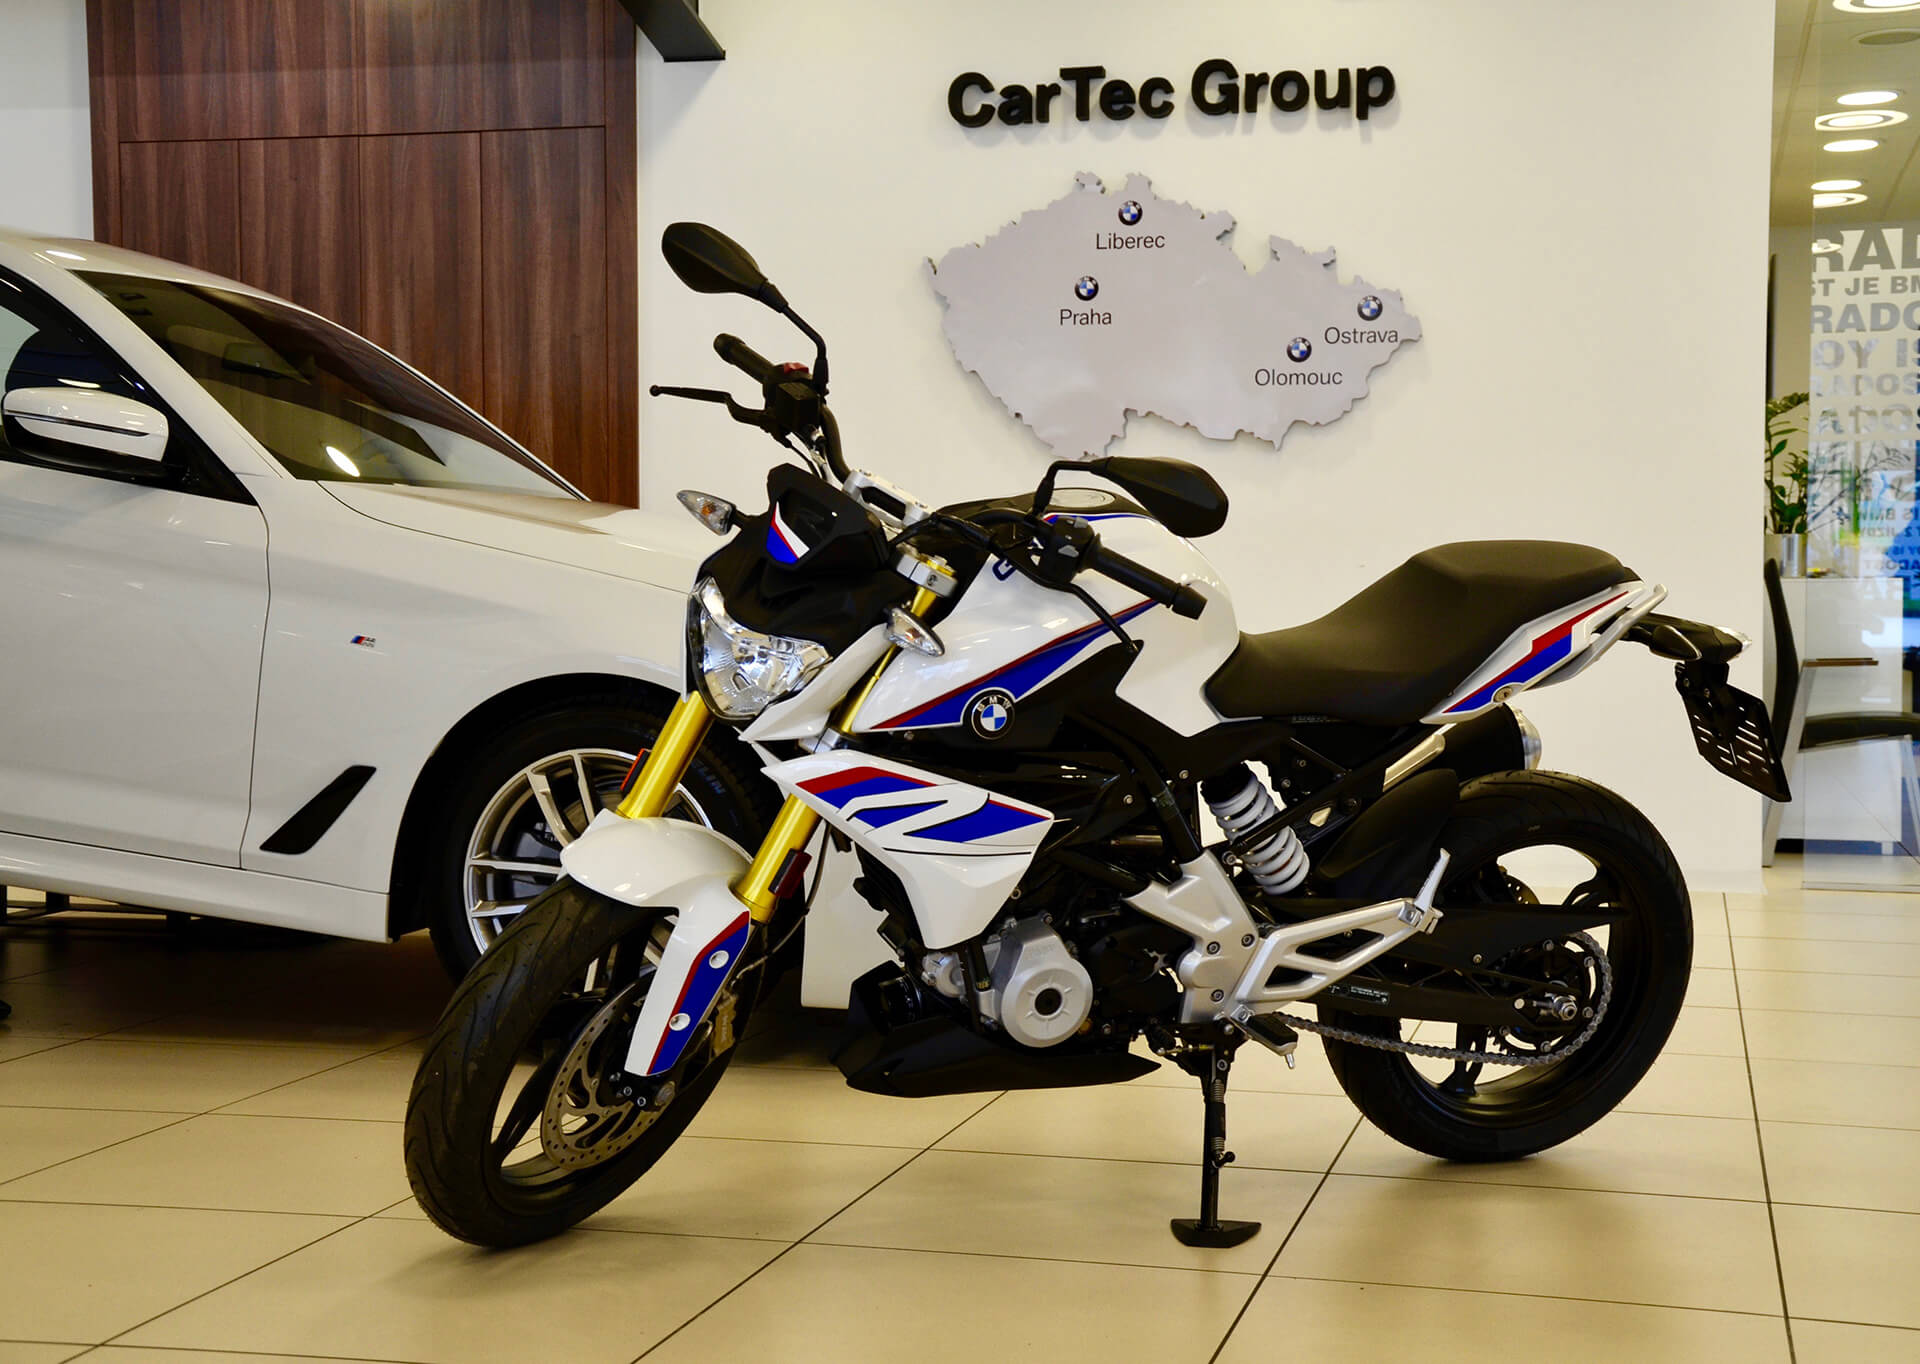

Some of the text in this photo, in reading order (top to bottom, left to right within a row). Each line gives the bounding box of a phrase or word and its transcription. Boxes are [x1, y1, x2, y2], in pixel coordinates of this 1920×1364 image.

[948, 58, 1396, 128] CarTec Group
[1096, 232, 1166, 250] Liberec
[1844, 276, 1880, 296] JE
[1060, 308, 1112, 326] Praha
[1324, 326, 1399, 344] Ostrava
[1254, 368, 1343, 386] Olomouc
